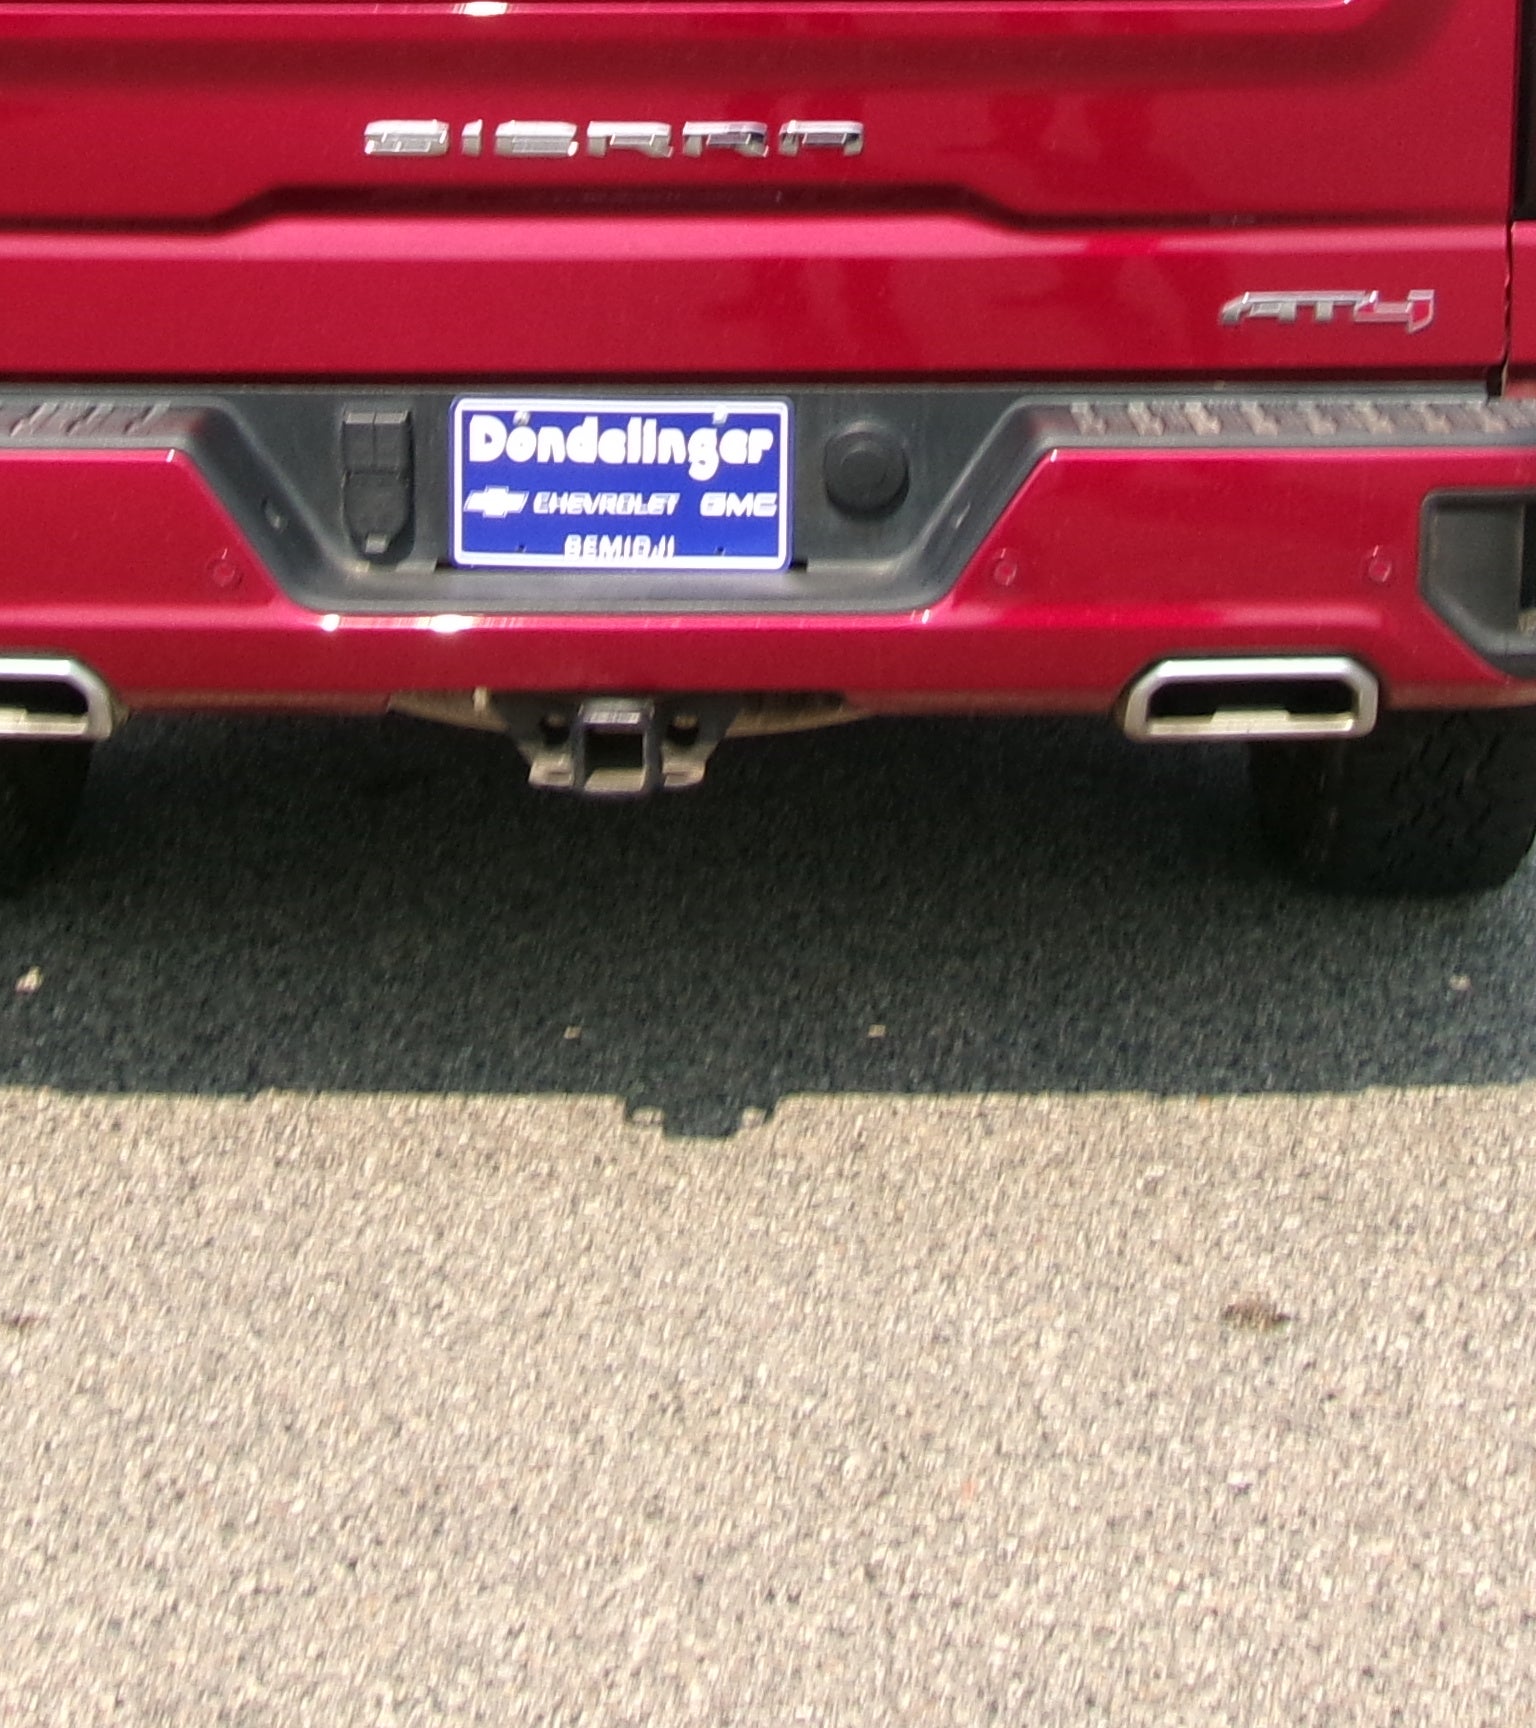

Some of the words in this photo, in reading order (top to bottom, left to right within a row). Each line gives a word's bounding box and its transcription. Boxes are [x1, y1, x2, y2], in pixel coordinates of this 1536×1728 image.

[365, 119, 864, 157] SIERRA
[1221, 289, 1435, 334] AT4
[469, 414, 774, 481] Dondelinger
[533, 490, 681, 516] CHEVROLET
[700, 491, 778, 517] GMC
